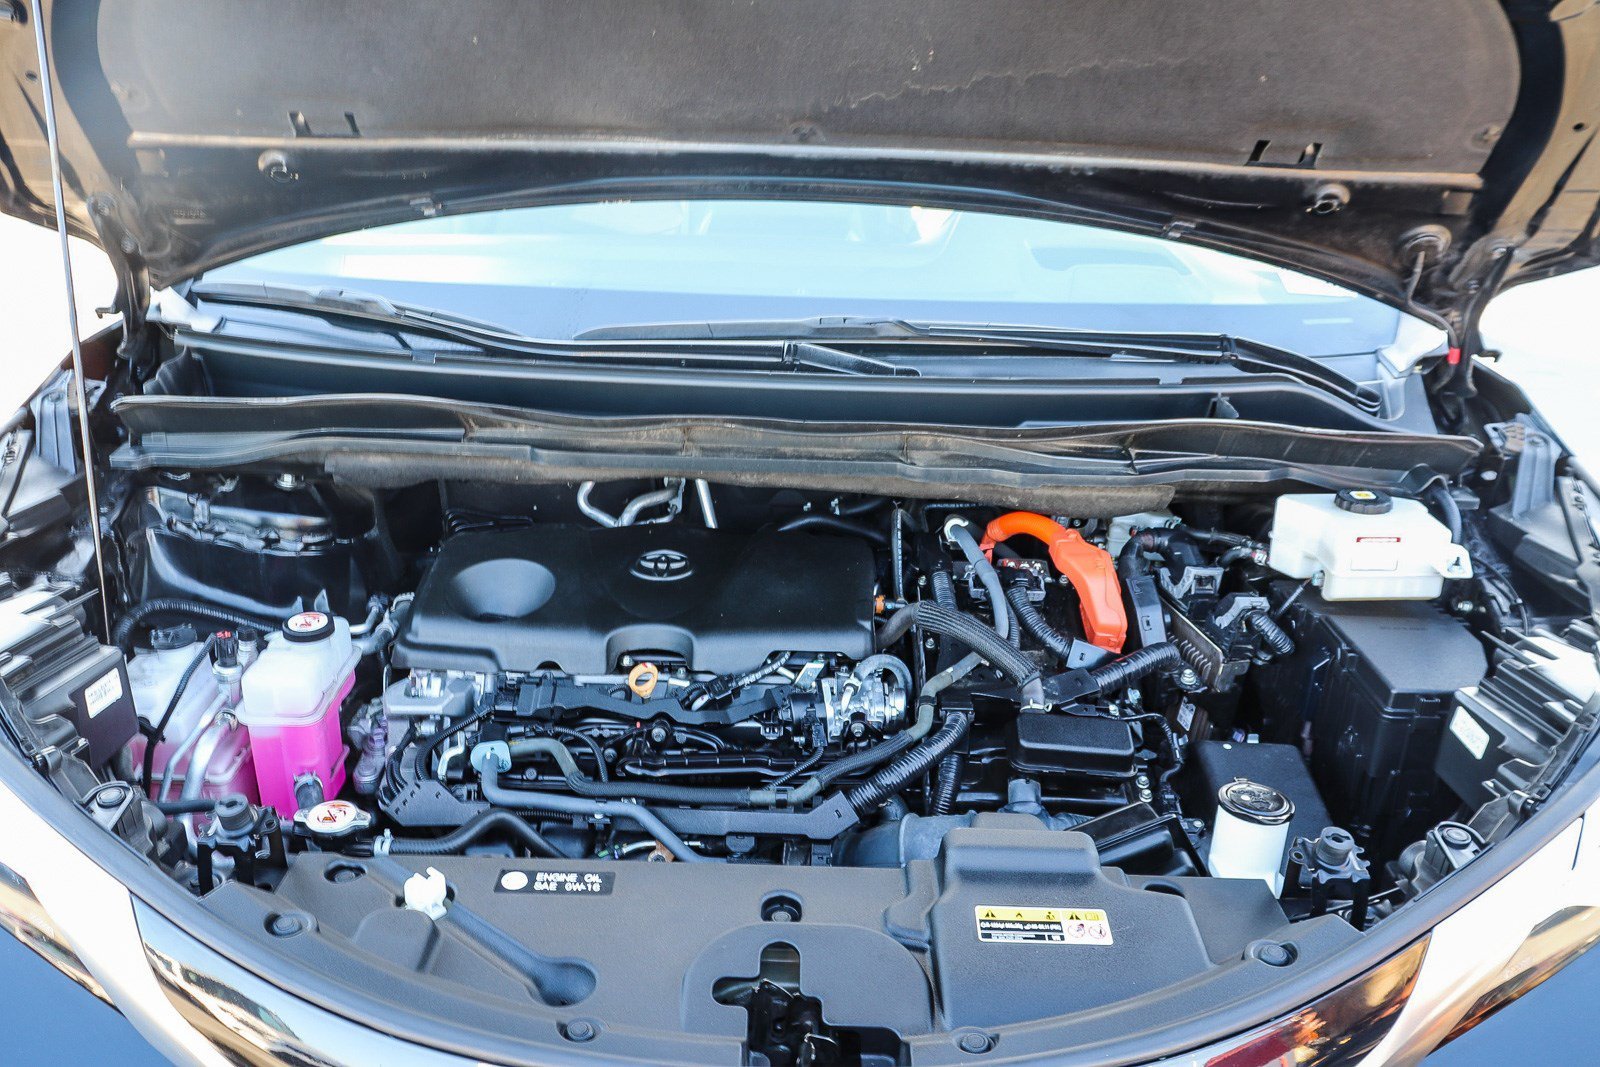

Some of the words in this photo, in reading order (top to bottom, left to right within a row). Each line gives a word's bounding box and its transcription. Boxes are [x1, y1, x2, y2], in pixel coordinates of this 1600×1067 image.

[536, 872, 578, 882] ENGINE
[584, 873, 602, 883] OIL
[533, 882, 558, 891] SAE
